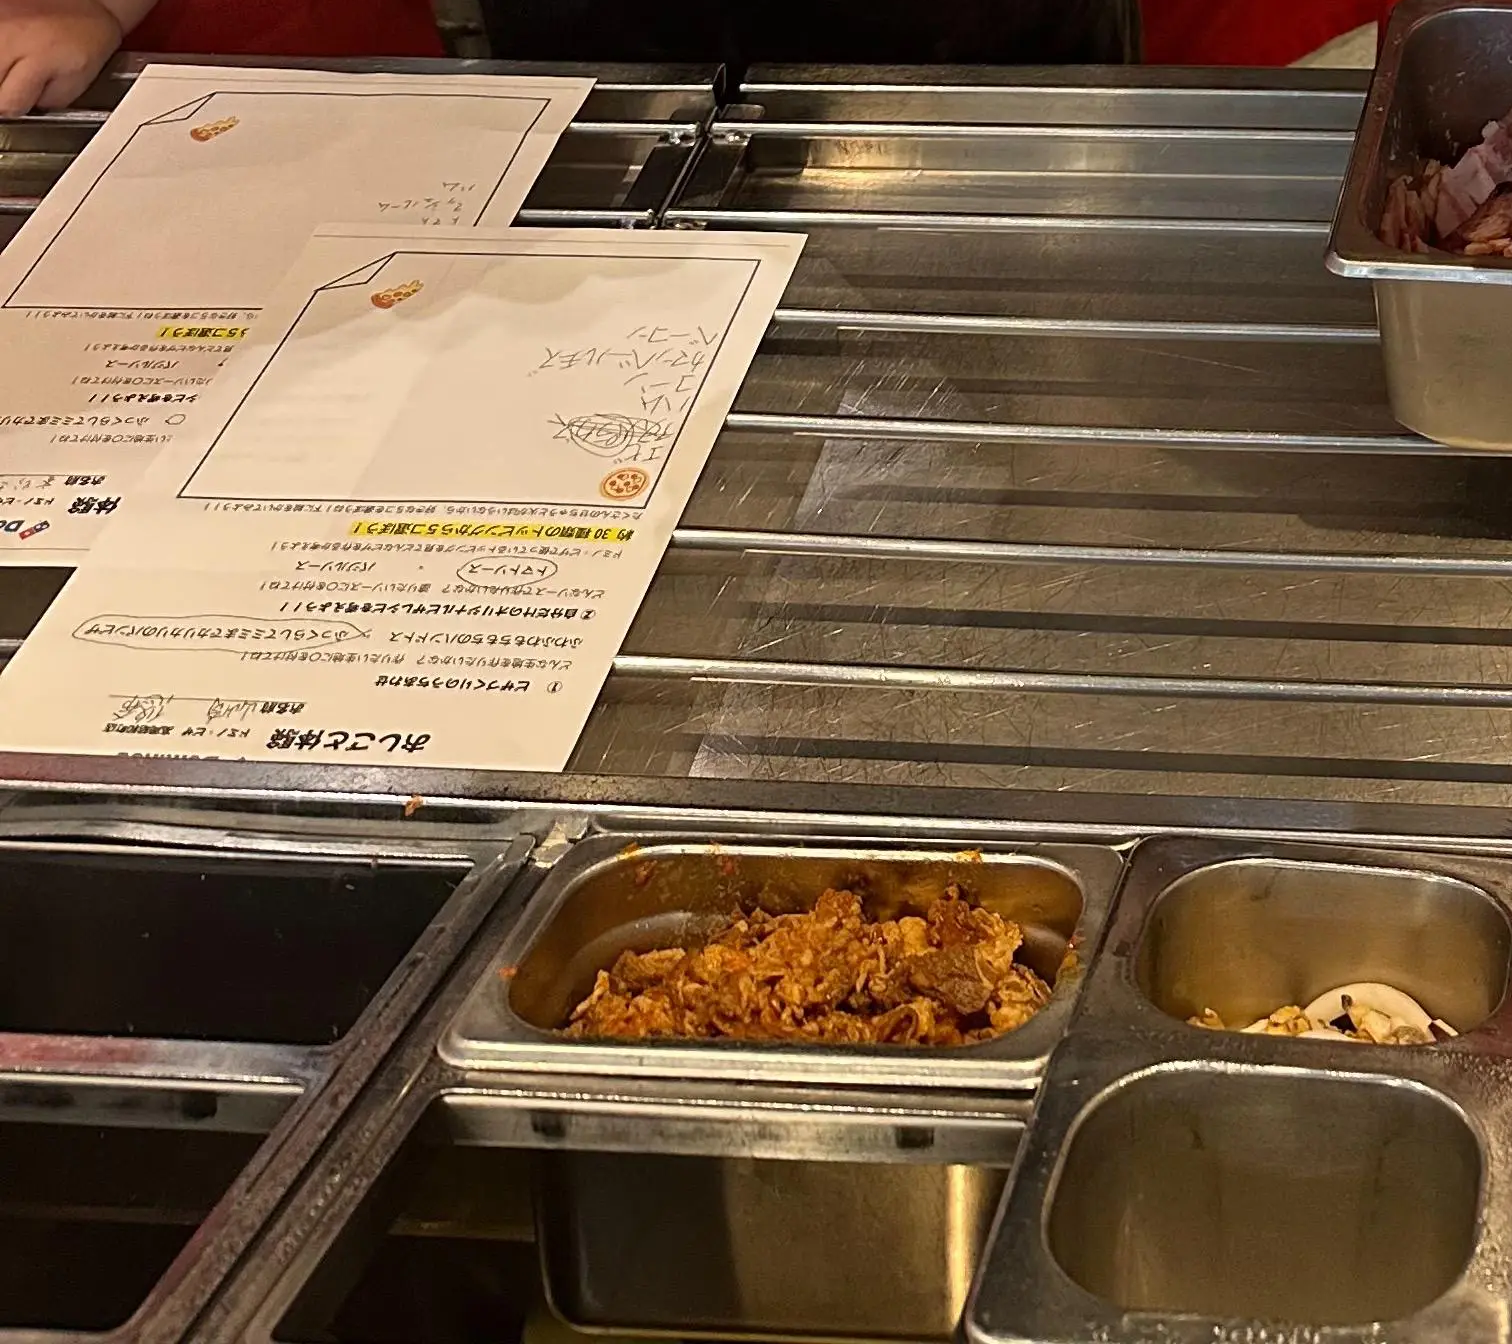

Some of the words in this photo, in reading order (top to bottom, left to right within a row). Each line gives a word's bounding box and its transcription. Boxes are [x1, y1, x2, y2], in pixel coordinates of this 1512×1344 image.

[626, 325, 718, 346] ベーコン
[640, 394, 691, 416] ハム
[294, 560, 377, 573] バジルソース
[468, 563, 548, 577] トマトソース
[83, 623, 351, 642] ふっくらしてミミまでカリカリのパンピザ
[389, 631, 584, 650] ふわふわもちもちのハンドトス
[374, 675, 532, 693] ピザづくりのうちあわせ
[259, 701, 306, 716] お名前
[266, 728, 432, 754] おしごと体験
